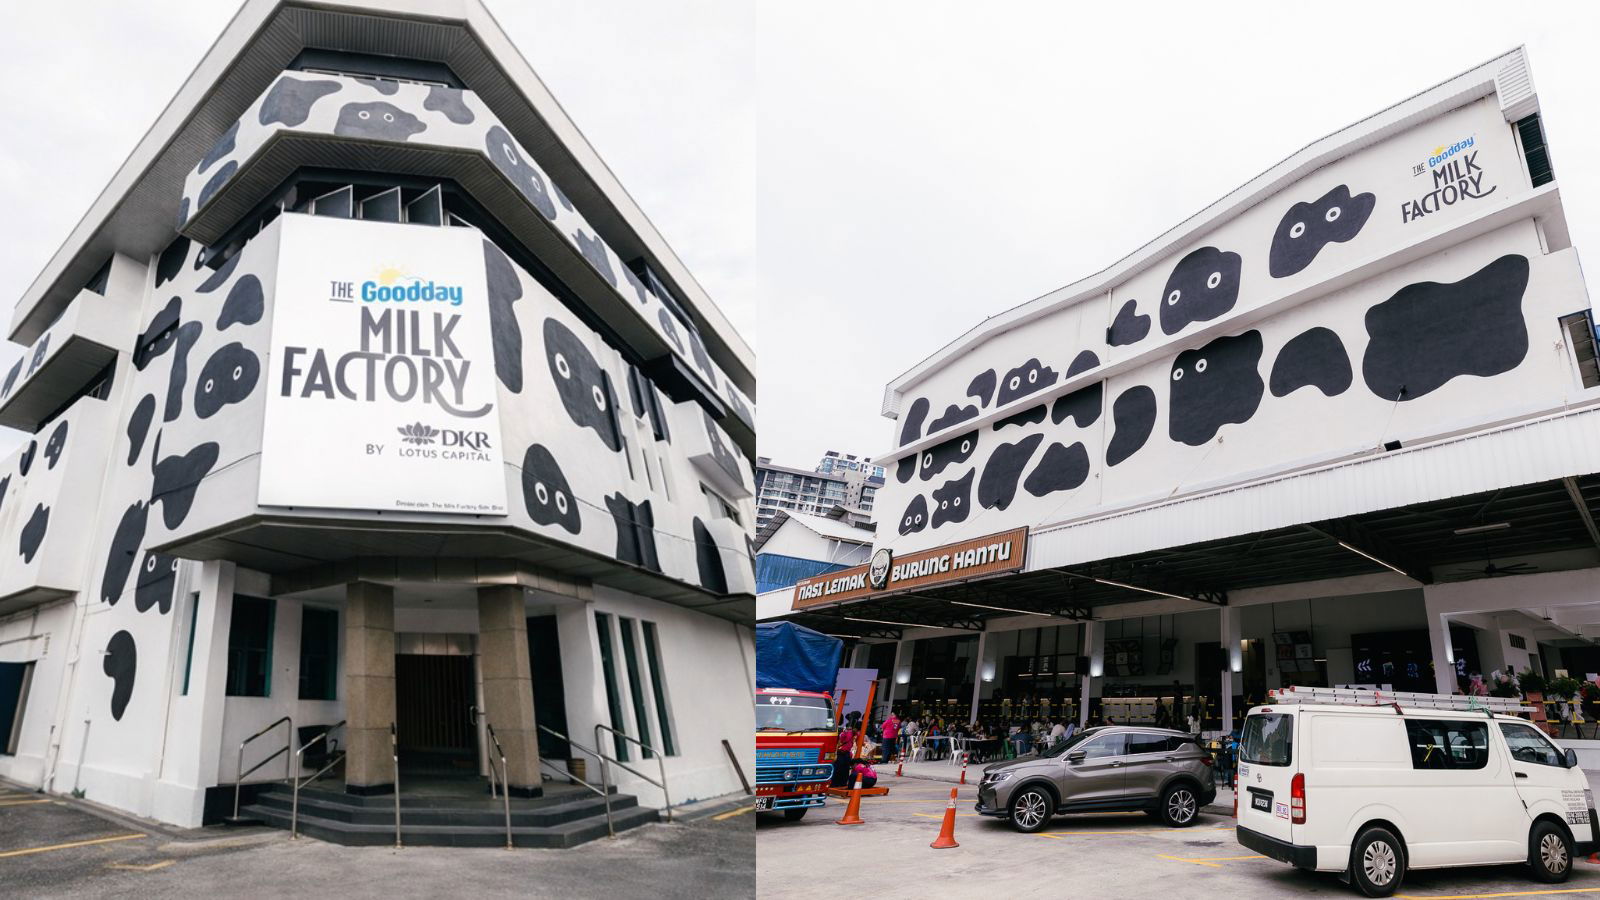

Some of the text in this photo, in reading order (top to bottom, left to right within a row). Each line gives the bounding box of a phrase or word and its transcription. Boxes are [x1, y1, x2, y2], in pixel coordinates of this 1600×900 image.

[1412, 136, 1475, 175] THE Goodday
[1432, 150, 1482, 189] MILK
[1401, 171, 1497, 224] FACTORY
[330, 280, 464, 306] THE Goodday
[360, 305, 464, 359] MILK
[280, 346, 494, 418] FACTORY
[366, 443, 384, 455] BY
[399, 448, 491, 462] LOTUS CAPITAL
[441, 429, 492, 451] DKR
[798, 541, 1012, 600] NASI LEMAK BURUNG HANTU
